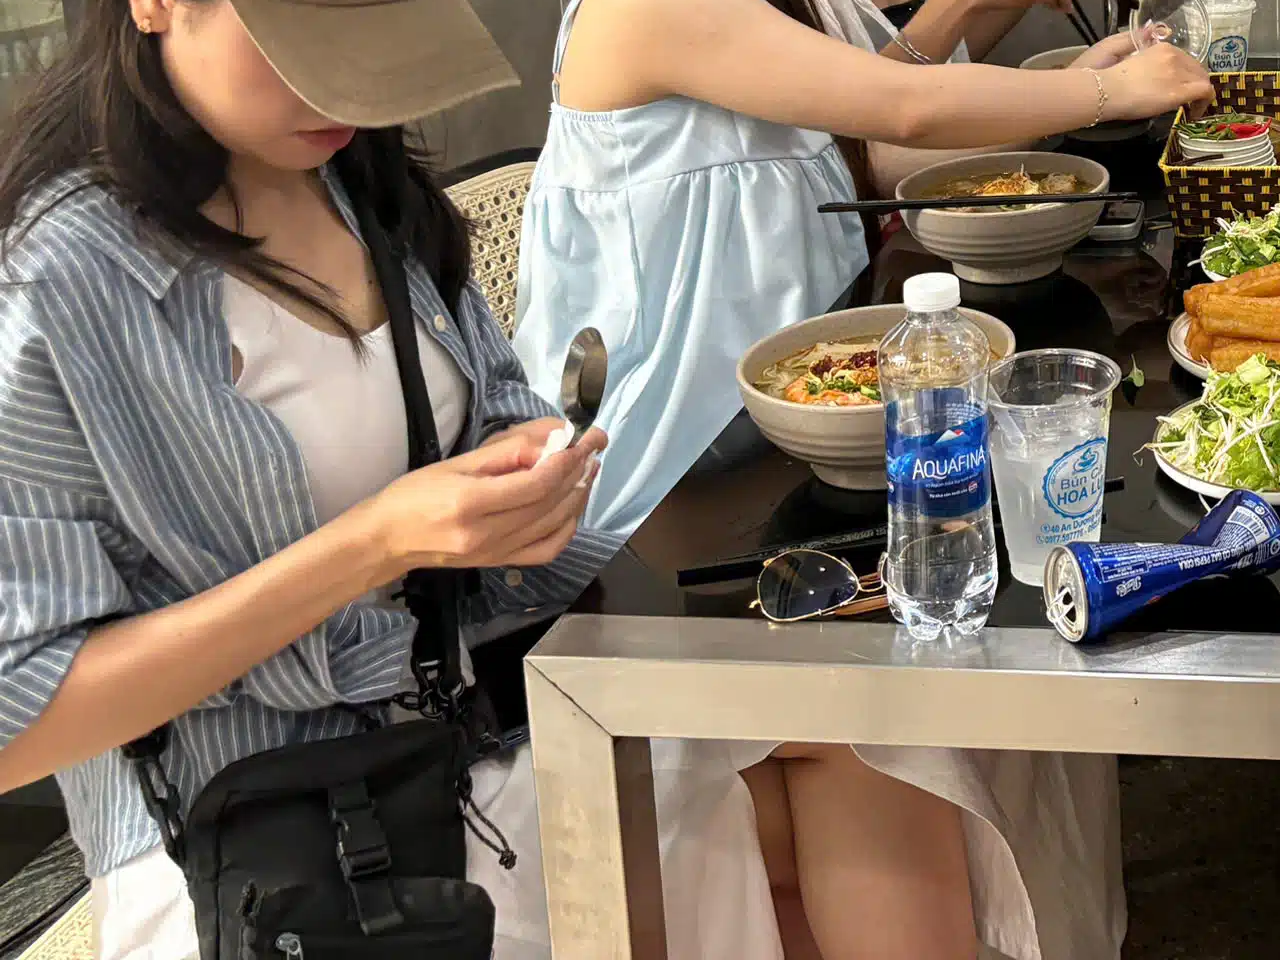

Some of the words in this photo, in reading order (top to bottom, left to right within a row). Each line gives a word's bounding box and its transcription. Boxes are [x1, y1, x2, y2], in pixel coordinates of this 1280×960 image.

[1212, 60, 1232, 68] HOA
[912, 444, 986, 480] AQUAFINA
[1061, 476, 1087, 490] Bún
[1057, 486, 1088, 505] HOA
